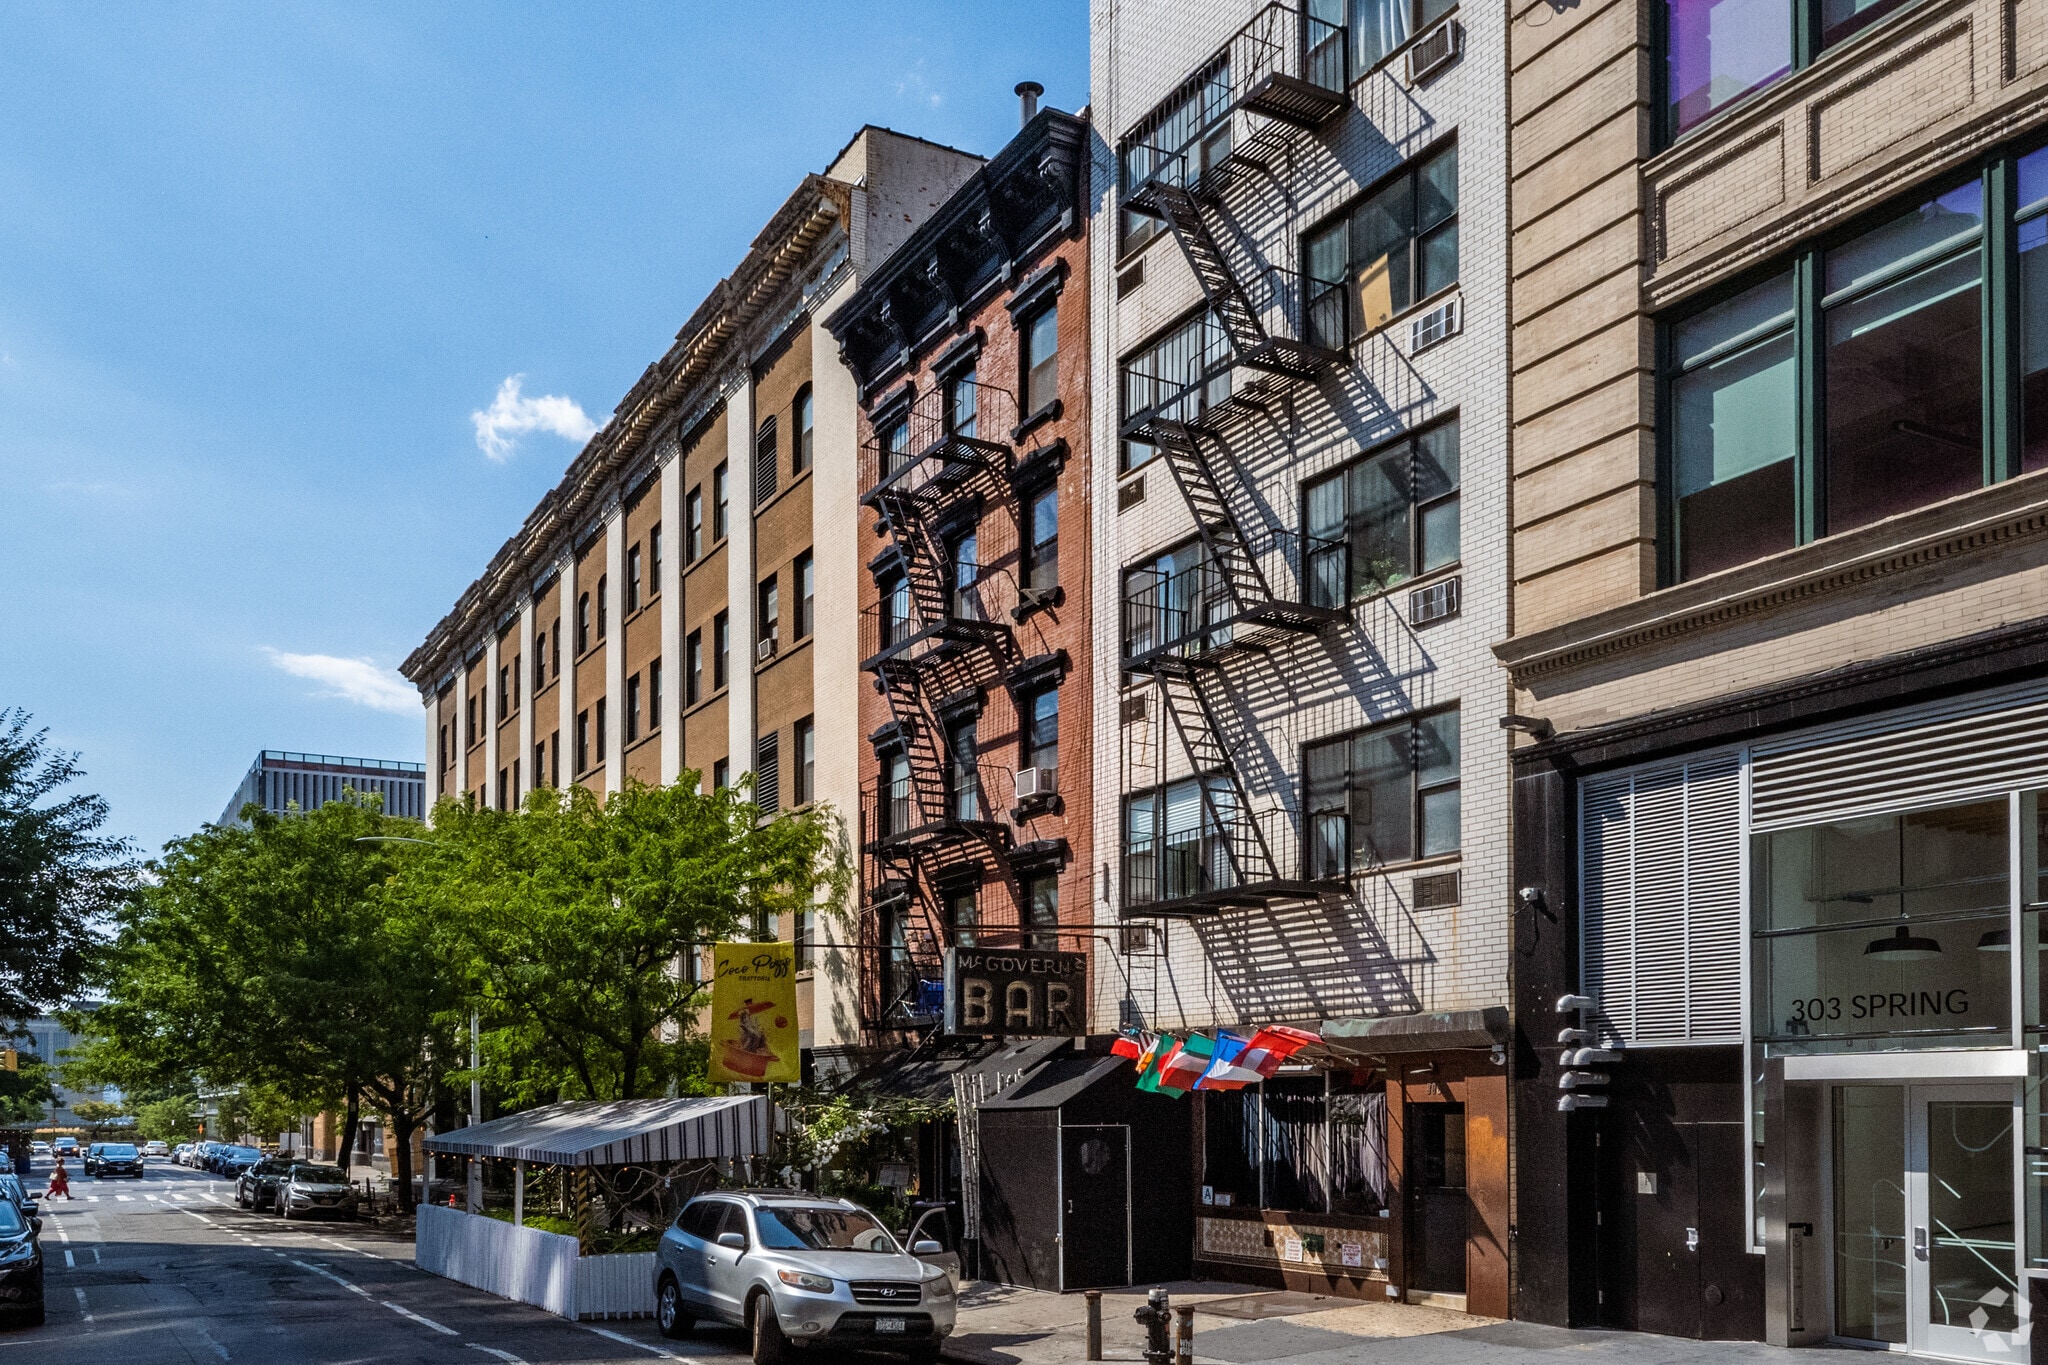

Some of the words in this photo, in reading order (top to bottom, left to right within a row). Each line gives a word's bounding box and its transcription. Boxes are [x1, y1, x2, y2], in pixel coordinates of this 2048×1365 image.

[718, 959, 749, 978] Coco
[963, 977, 1079, 1029] BAR
[1791, 997, 1841, 1022] 303
[1851, 989, 1968, 1019] SPRING
[1204, 1187, 1211, 1200] A
